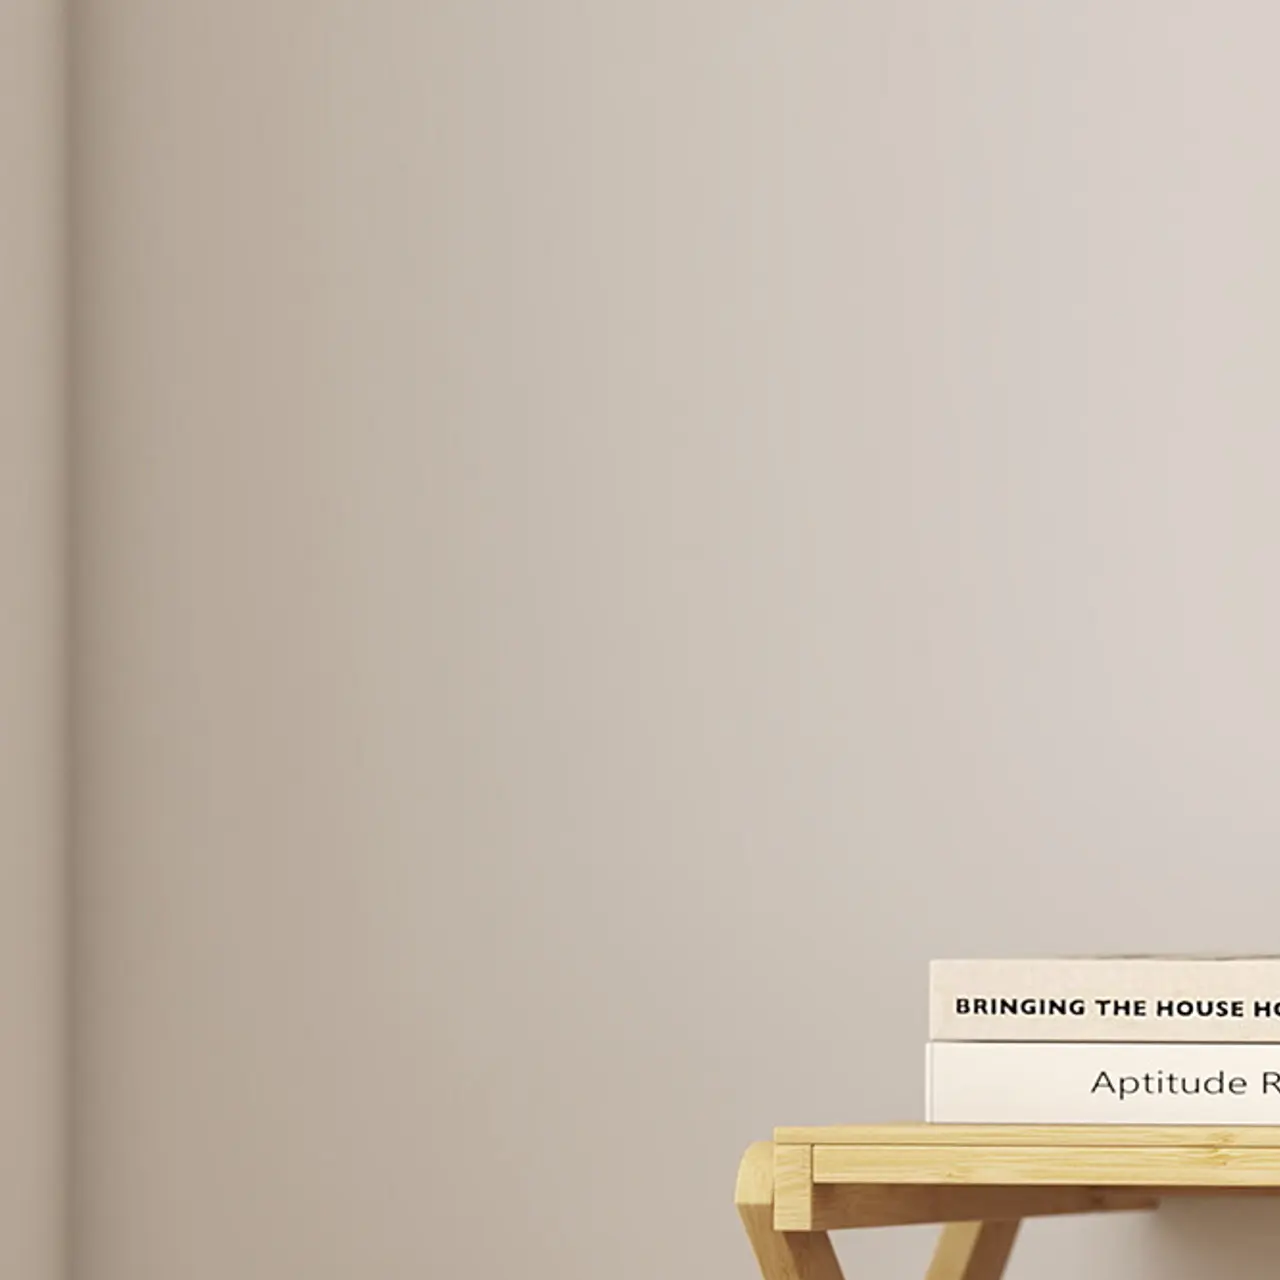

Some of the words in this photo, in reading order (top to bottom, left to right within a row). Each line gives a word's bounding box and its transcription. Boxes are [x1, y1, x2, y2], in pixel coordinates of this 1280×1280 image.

[955, 998, 1085, 1016] BRINGING
[1094, 999, 1147, 1017] THE
[1156, 1000, 1244, 1018] HOUSE
[1091, 1070, 1248, 1101] Aptitude
